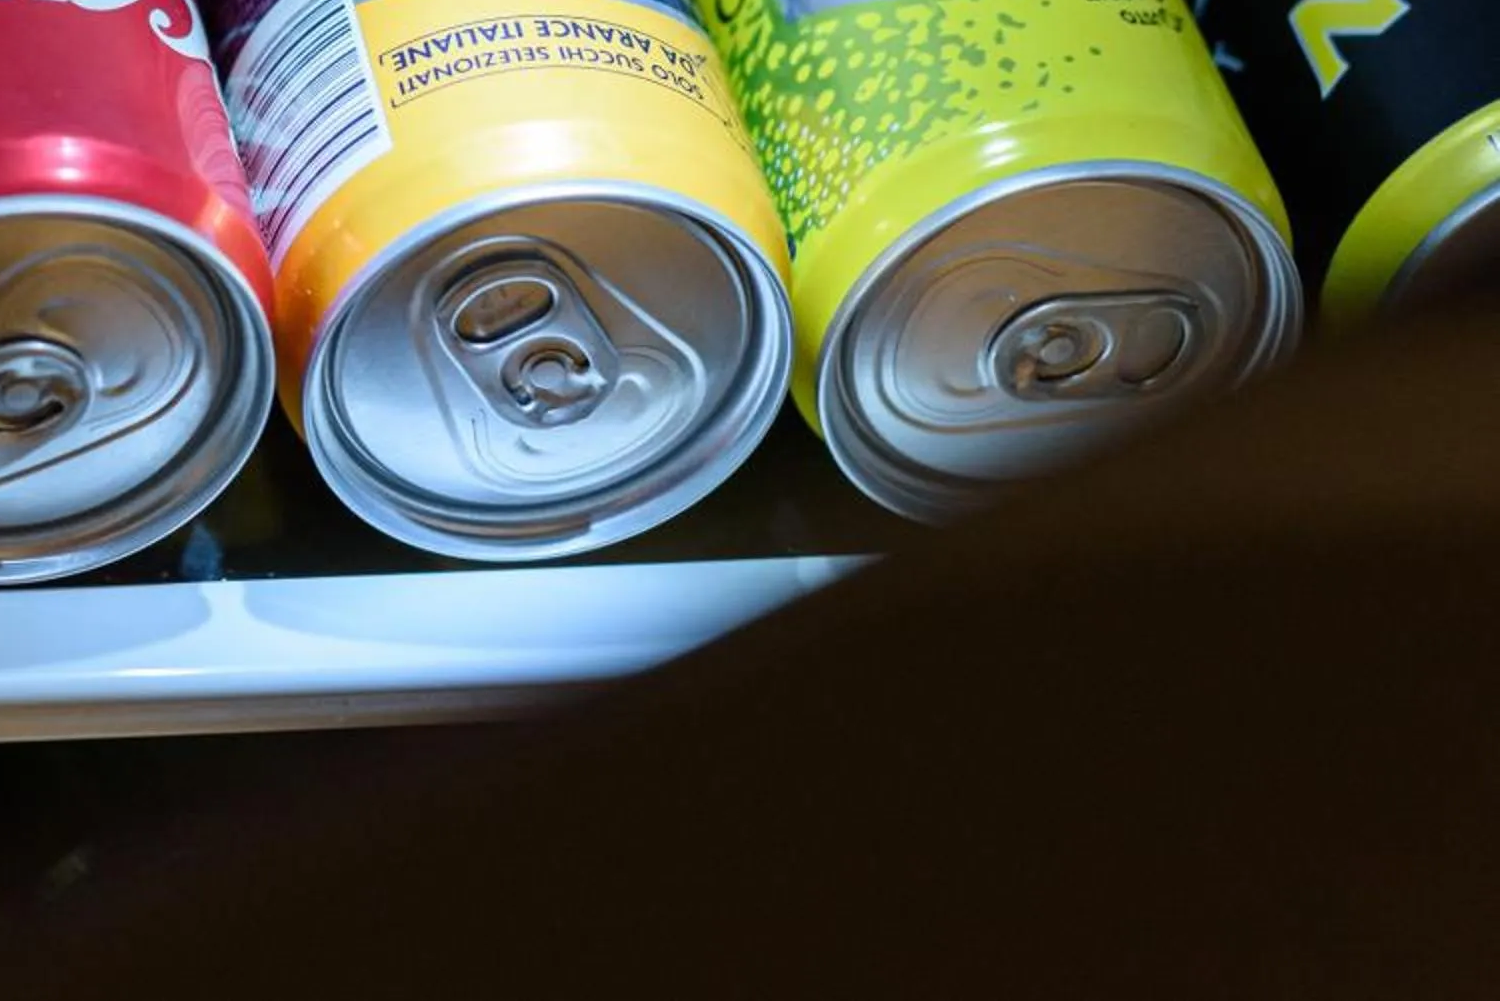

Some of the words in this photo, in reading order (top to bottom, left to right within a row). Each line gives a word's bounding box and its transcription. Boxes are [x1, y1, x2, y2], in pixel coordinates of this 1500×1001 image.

[391, 20, 524, 73] ITALIANE
[533, 19, 652, 54] ARANCE
[397, 45, 549, 96] SELEZIONATI
[558, 45, 645, 73] SUCCHI
[660, 45, 696, 77] DA
[651, 64, 705, 101] SOLO
